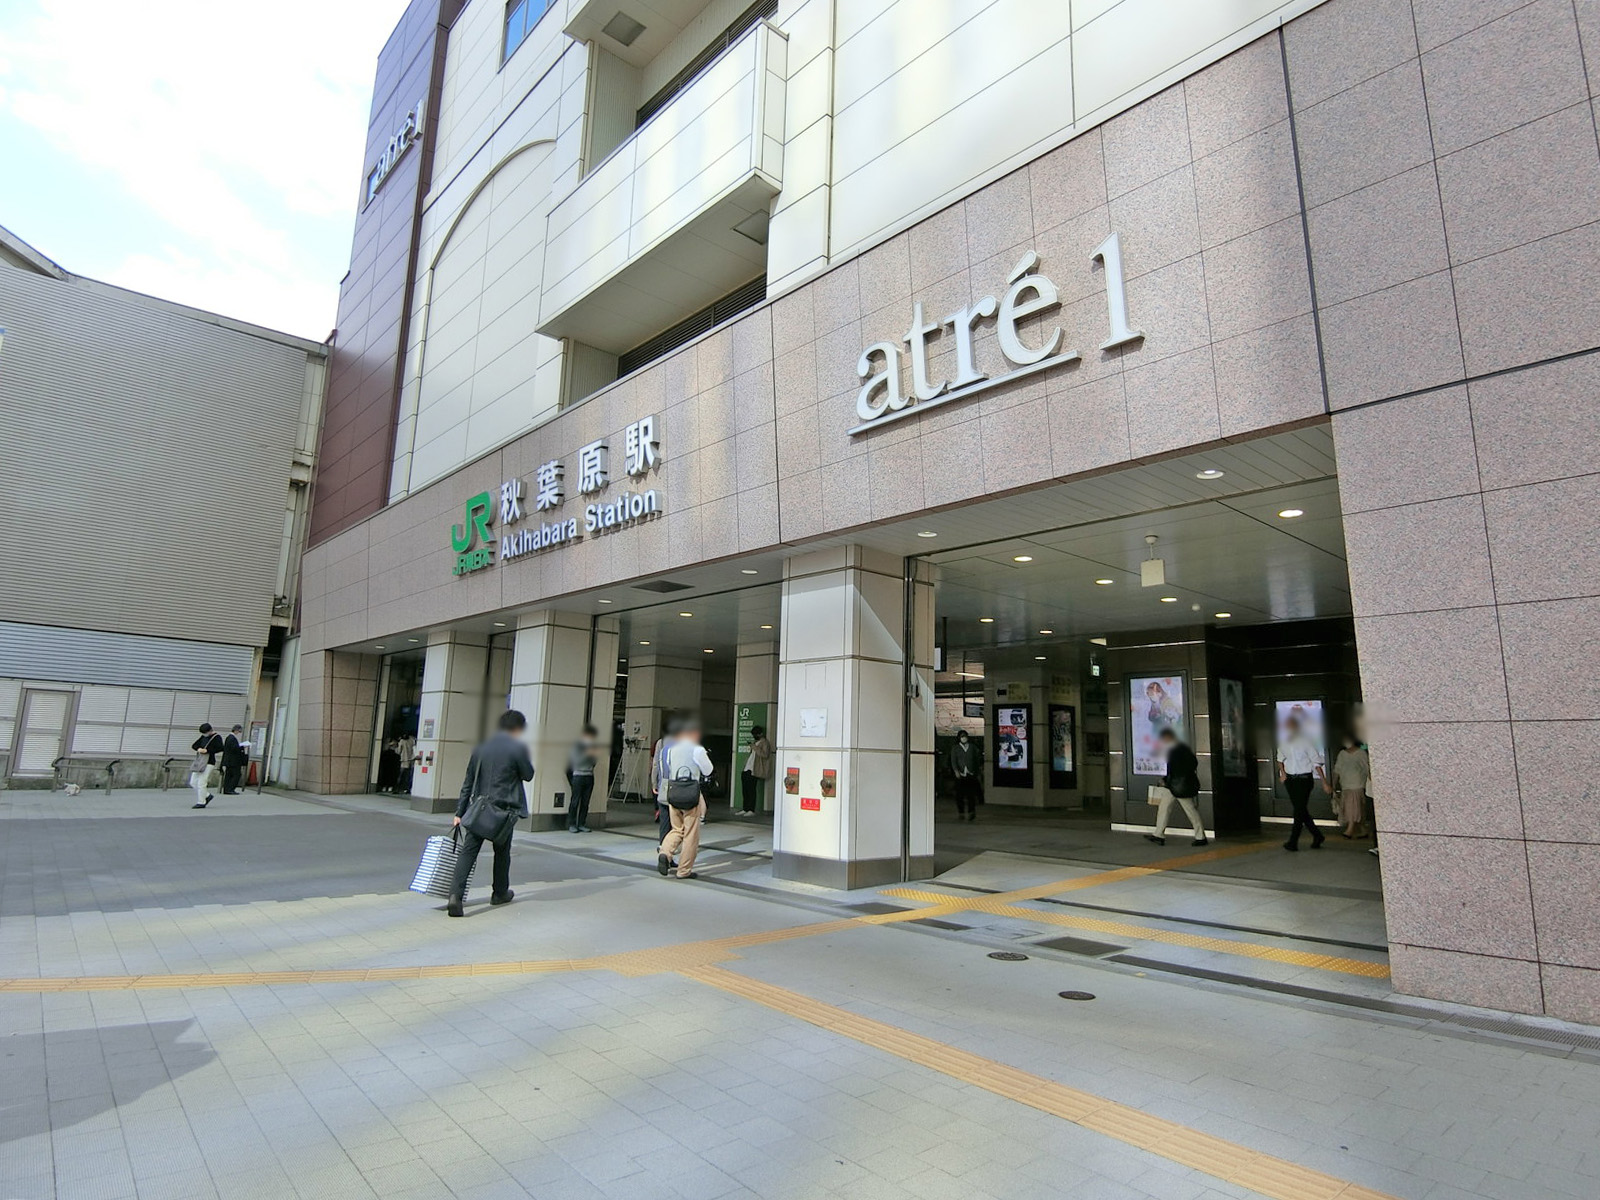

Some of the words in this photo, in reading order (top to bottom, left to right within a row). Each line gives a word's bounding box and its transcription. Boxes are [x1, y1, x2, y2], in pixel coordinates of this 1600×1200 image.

[856, 250, 1064, 421] atré
[1089, 230, 1145, 351] 1
[500, 414, 661, 525] 秋葉原駅
[451, 490, 495, 552] JR
[501, 516, 582, 560] Akihabara
[584, 489, 661, 533] Station
